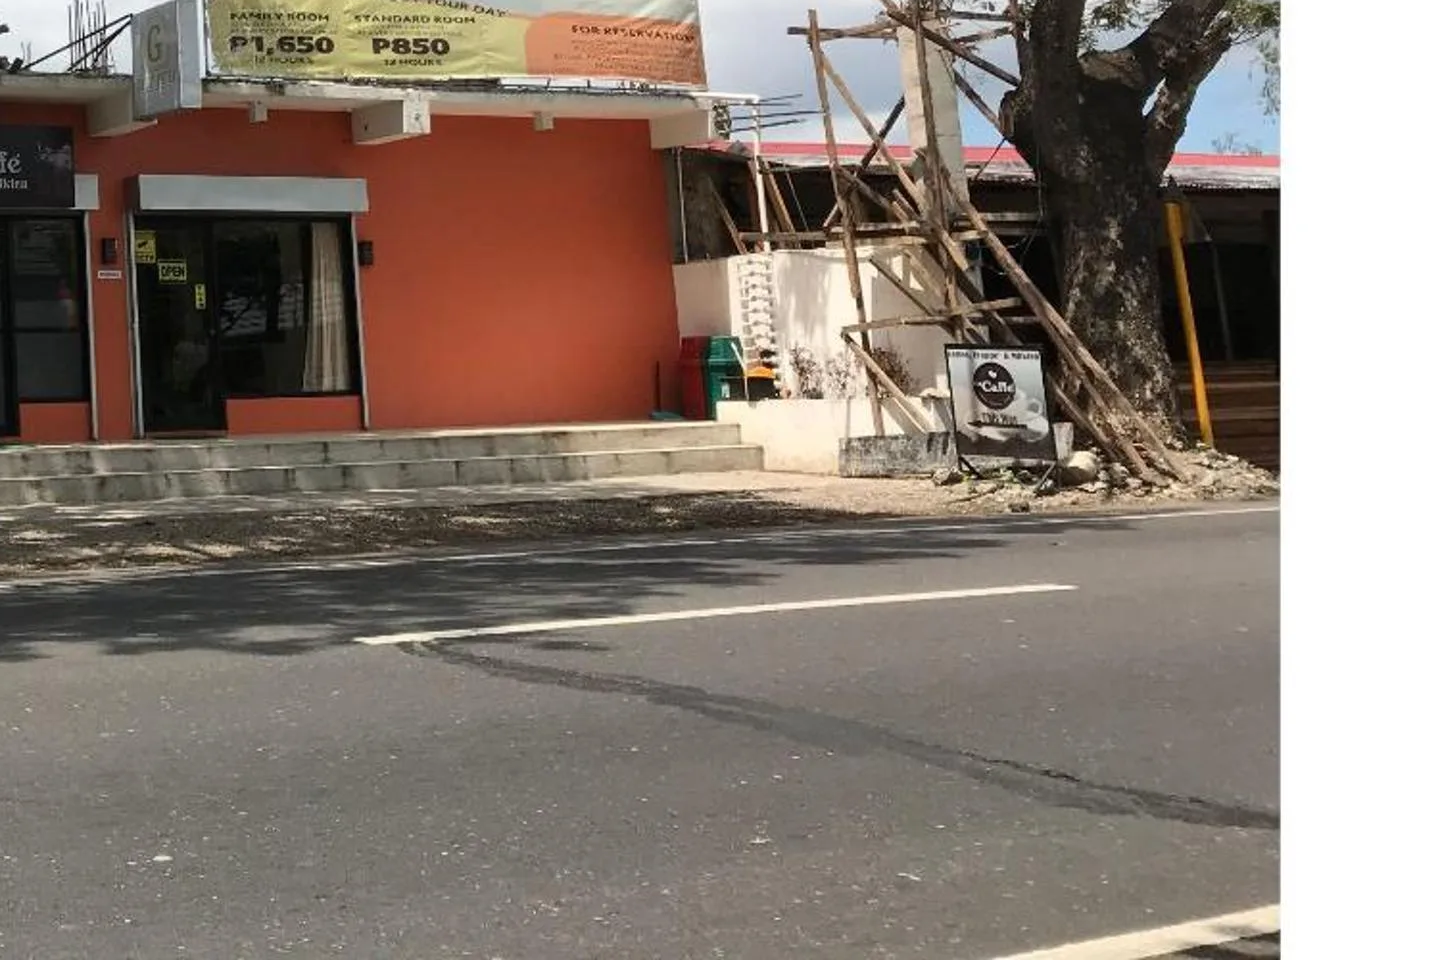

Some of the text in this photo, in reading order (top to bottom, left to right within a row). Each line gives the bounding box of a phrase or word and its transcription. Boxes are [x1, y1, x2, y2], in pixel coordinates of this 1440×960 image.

[287, 12, 330, 23] ROOM
[354, 14, 477, 25] STANDARD ROOM
[571, 24, 600, 36] FOR
[229, 35, 335, 56] P1,650
[372, 38, 451, 56] P850
[399, 58, 443, 67] HOURS
[161, 264, 186, 278] OPEN
